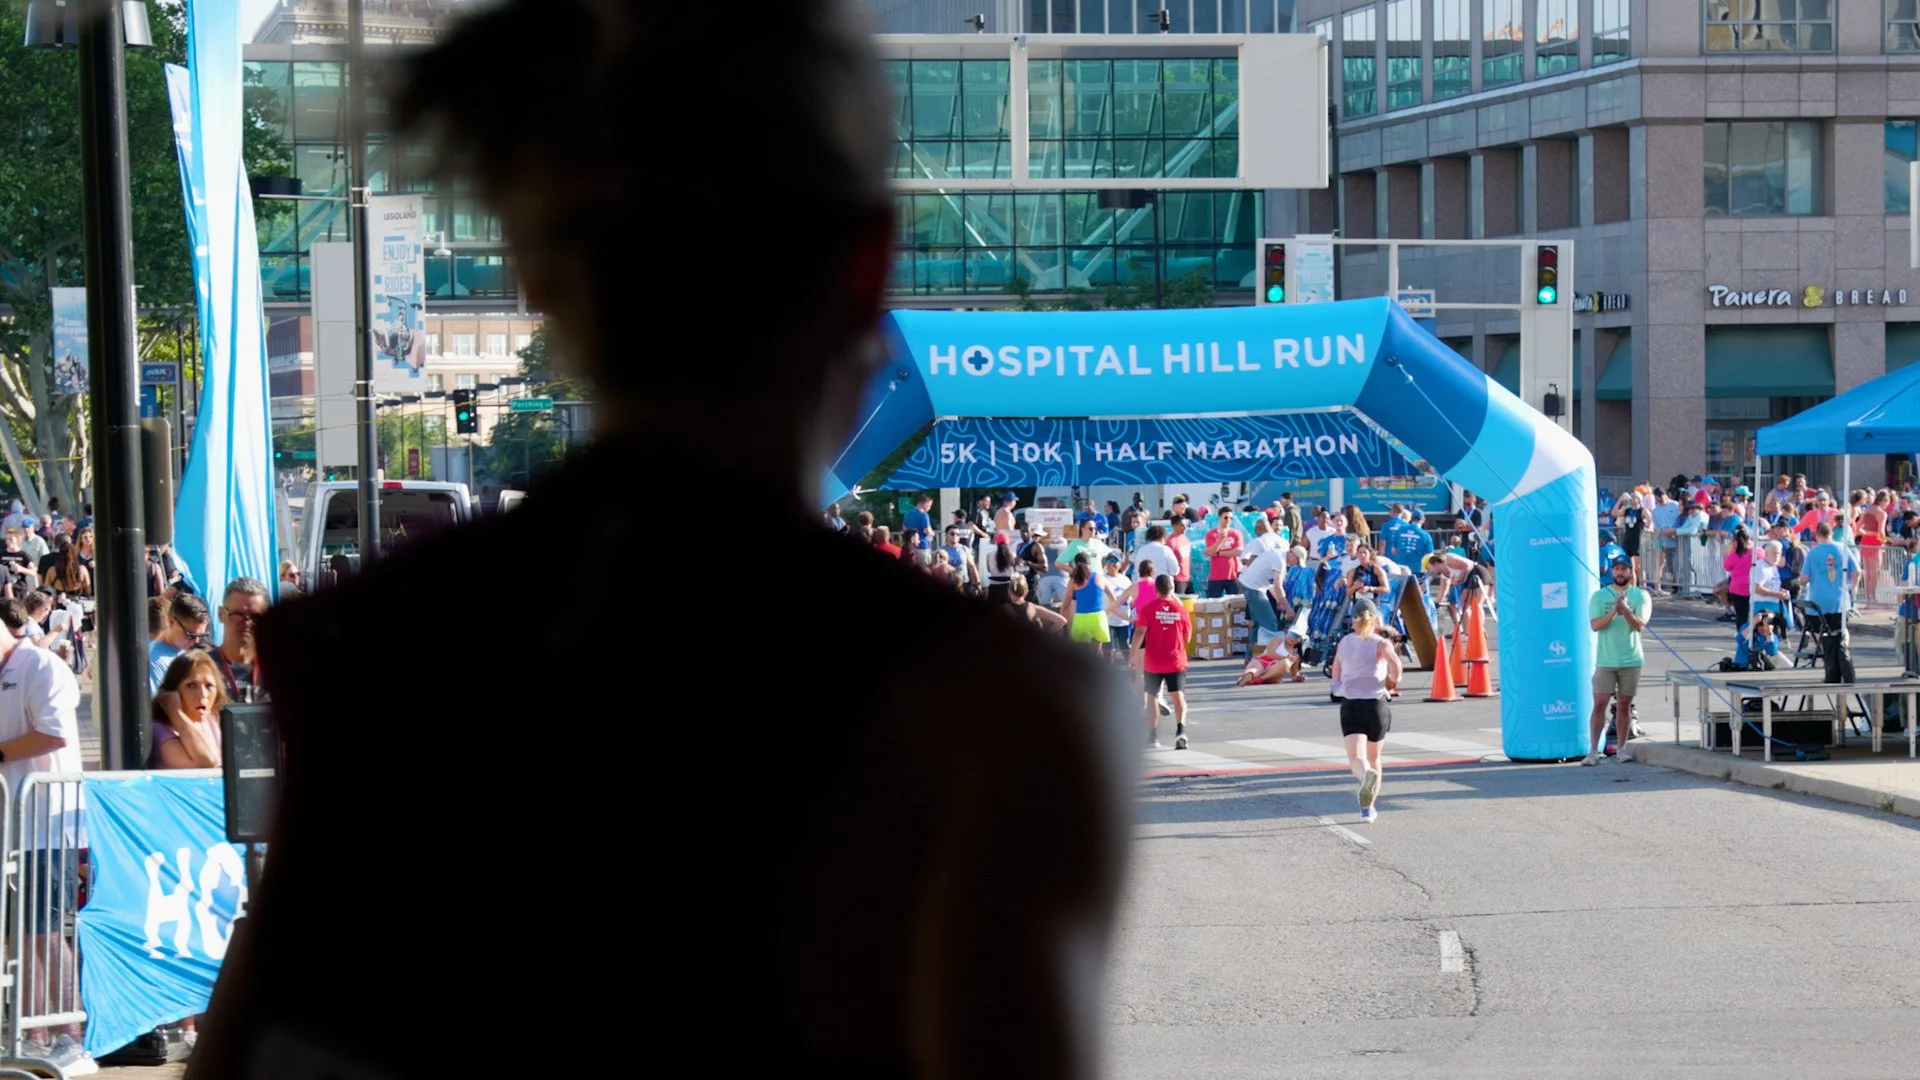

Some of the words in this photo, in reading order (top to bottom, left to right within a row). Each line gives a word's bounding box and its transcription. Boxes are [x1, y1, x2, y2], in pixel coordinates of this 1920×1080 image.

[383, 211, 416, 220] LEGOLAND
[383, 244, 412, 261] ENJOY
[384, 275, 412, 292] RIDES
[1709, 285, 1792, 307] Panera
[1836, 289, 1907, 305] BREAD
[929, 345, 1152, 376] HOSPITAL
[1163, 340, 1261, 374] HILL
[1273, 333, 1365, 369] RUN
[940, 443, 977, 463] 5K
[1008, 442, 1062, 463] 10K
[1095, 441, 1173, 461] HALF
[1186, 433, 1359, 460] MARATHON
